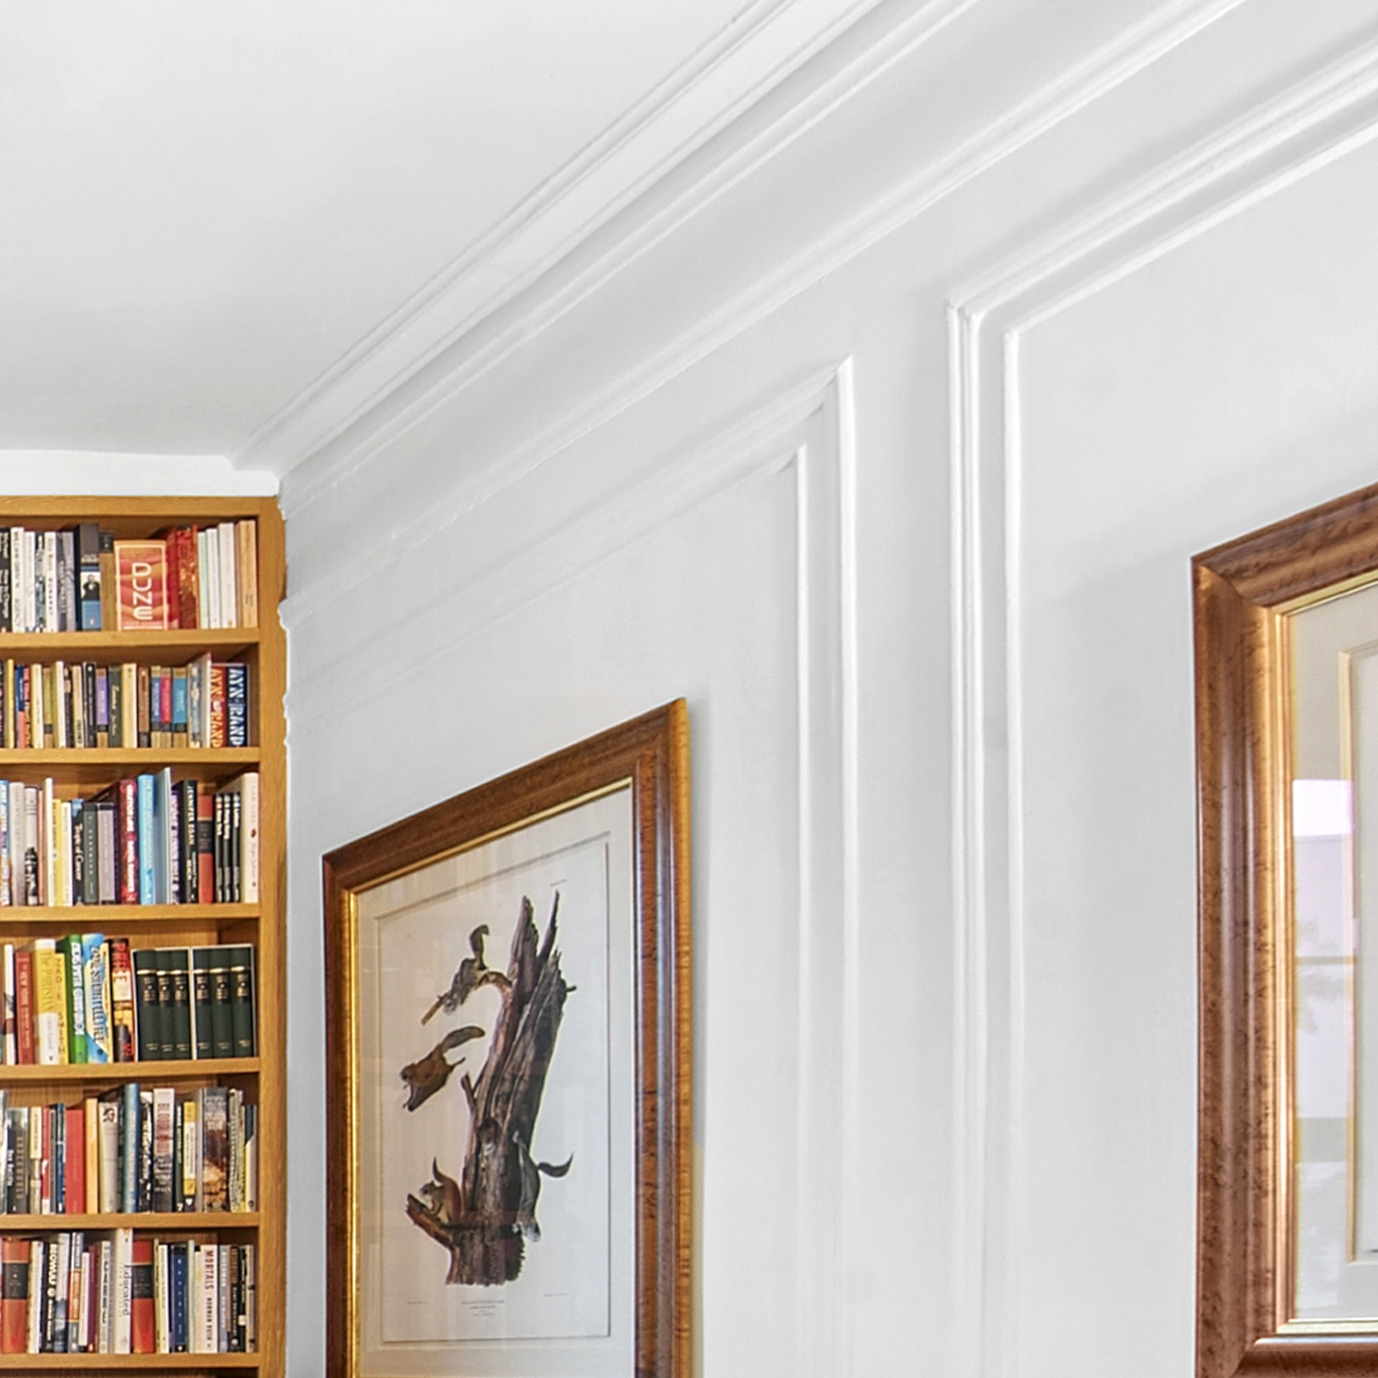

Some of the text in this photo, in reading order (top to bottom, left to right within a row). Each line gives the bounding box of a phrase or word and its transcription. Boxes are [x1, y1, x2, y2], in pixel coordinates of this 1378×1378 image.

[210, 669, 223, 747] AYN RAND
[228, 669, 245, 746] AYN RAND
[186, 785, 194, 822] JENNIFER
[75, 855, 83, 881] Cancer
[16, 1137, 25, 1199] UNDERWORLD
[49, 1244, 57, 1285] BEOWULF
[205, 1250, 214, 1290] MORTALS
[123, 1265, 131, 1316] Educated
